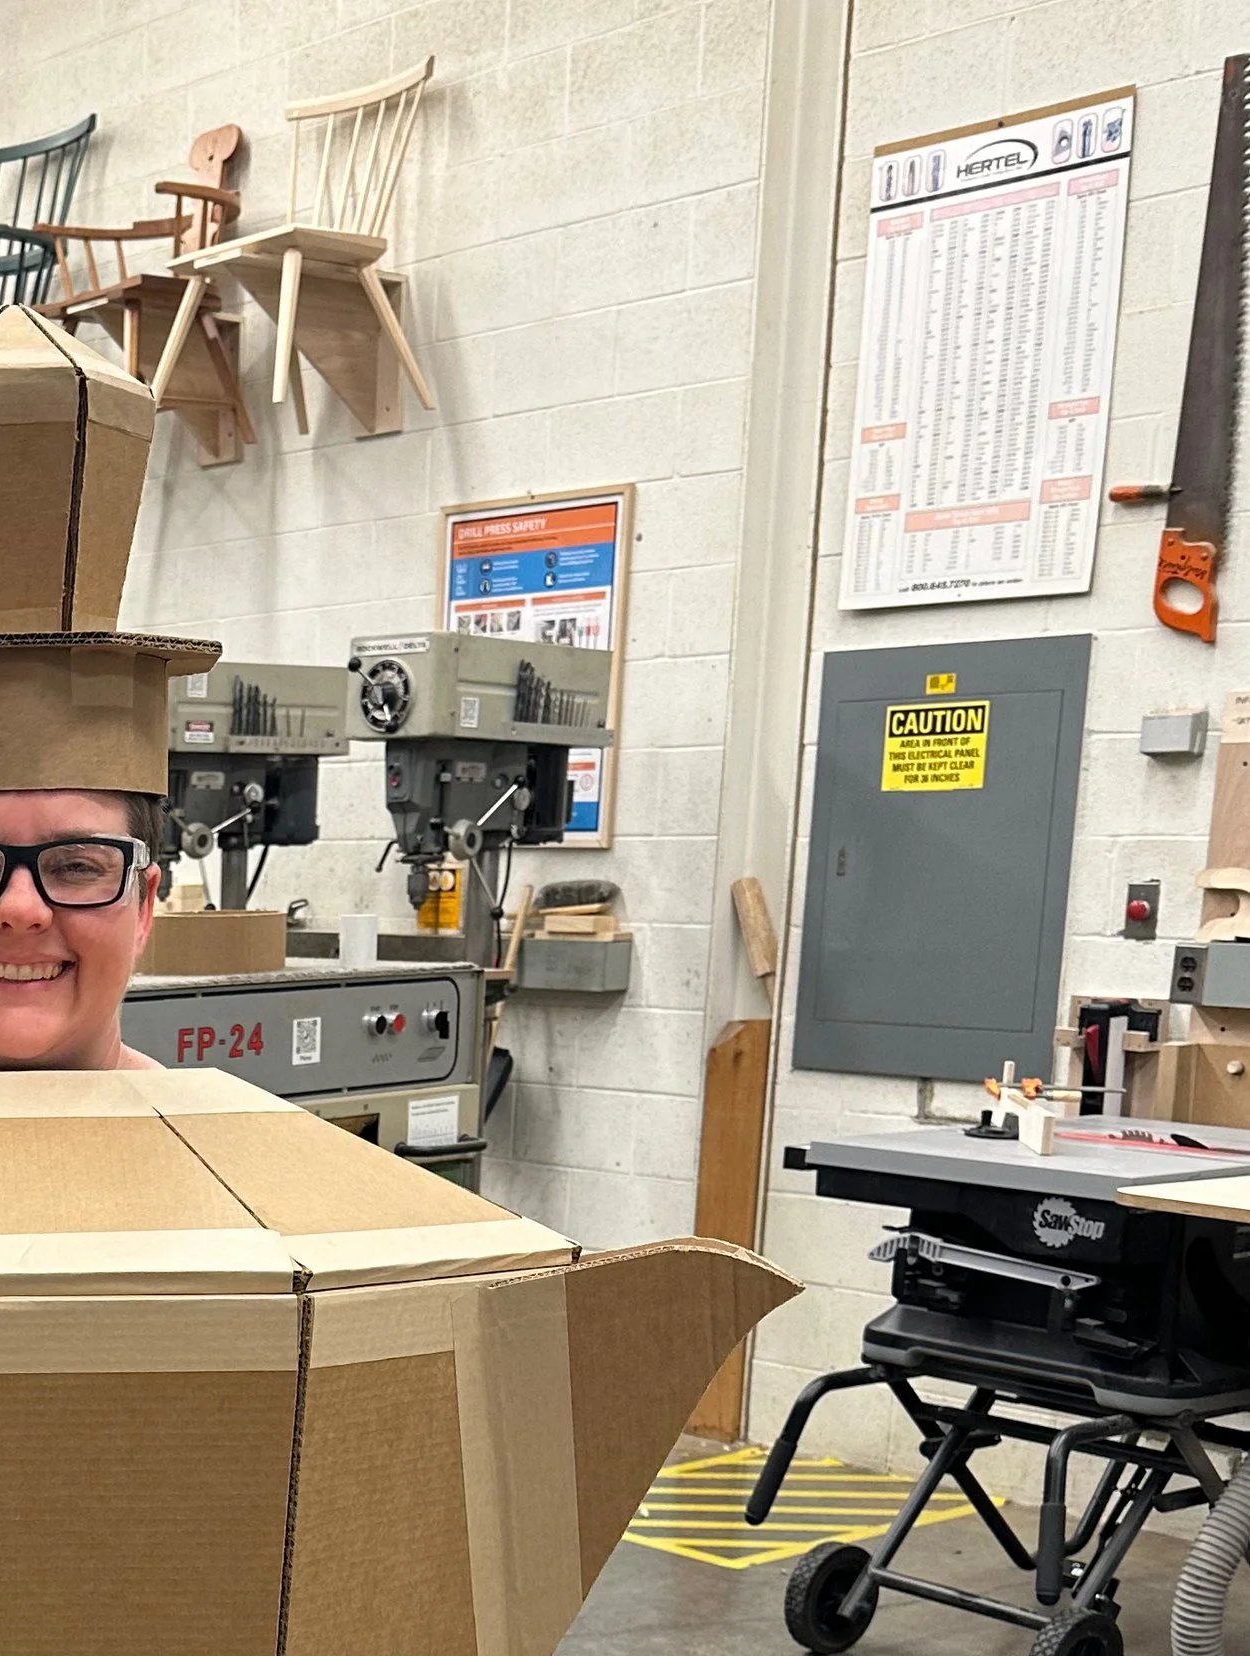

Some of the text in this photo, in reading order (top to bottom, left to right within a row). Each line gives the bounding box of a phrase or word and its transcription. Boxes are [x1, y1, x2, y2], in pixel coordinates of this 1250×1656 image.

[956, 152, 1029, 178] HERTEL
[458, 518, 547, 540] DRILL PRESS SAFETY
[891, 708, 983, 735] CAUTION
[900, 737, 971, 748] AREA IN FRONT OF
[889, 748, 980, 761] THIS ELECTRICAL PANEL
[892, 760, 975, 772] MUST BE KEPT CLEAR
[904, 775, 919, 784] FOR
[931, 773, 960, 782] INCHES
[176, 1022, 264, 1063] FP-24
[1039, 1209, 1105, 1240] SawStop
